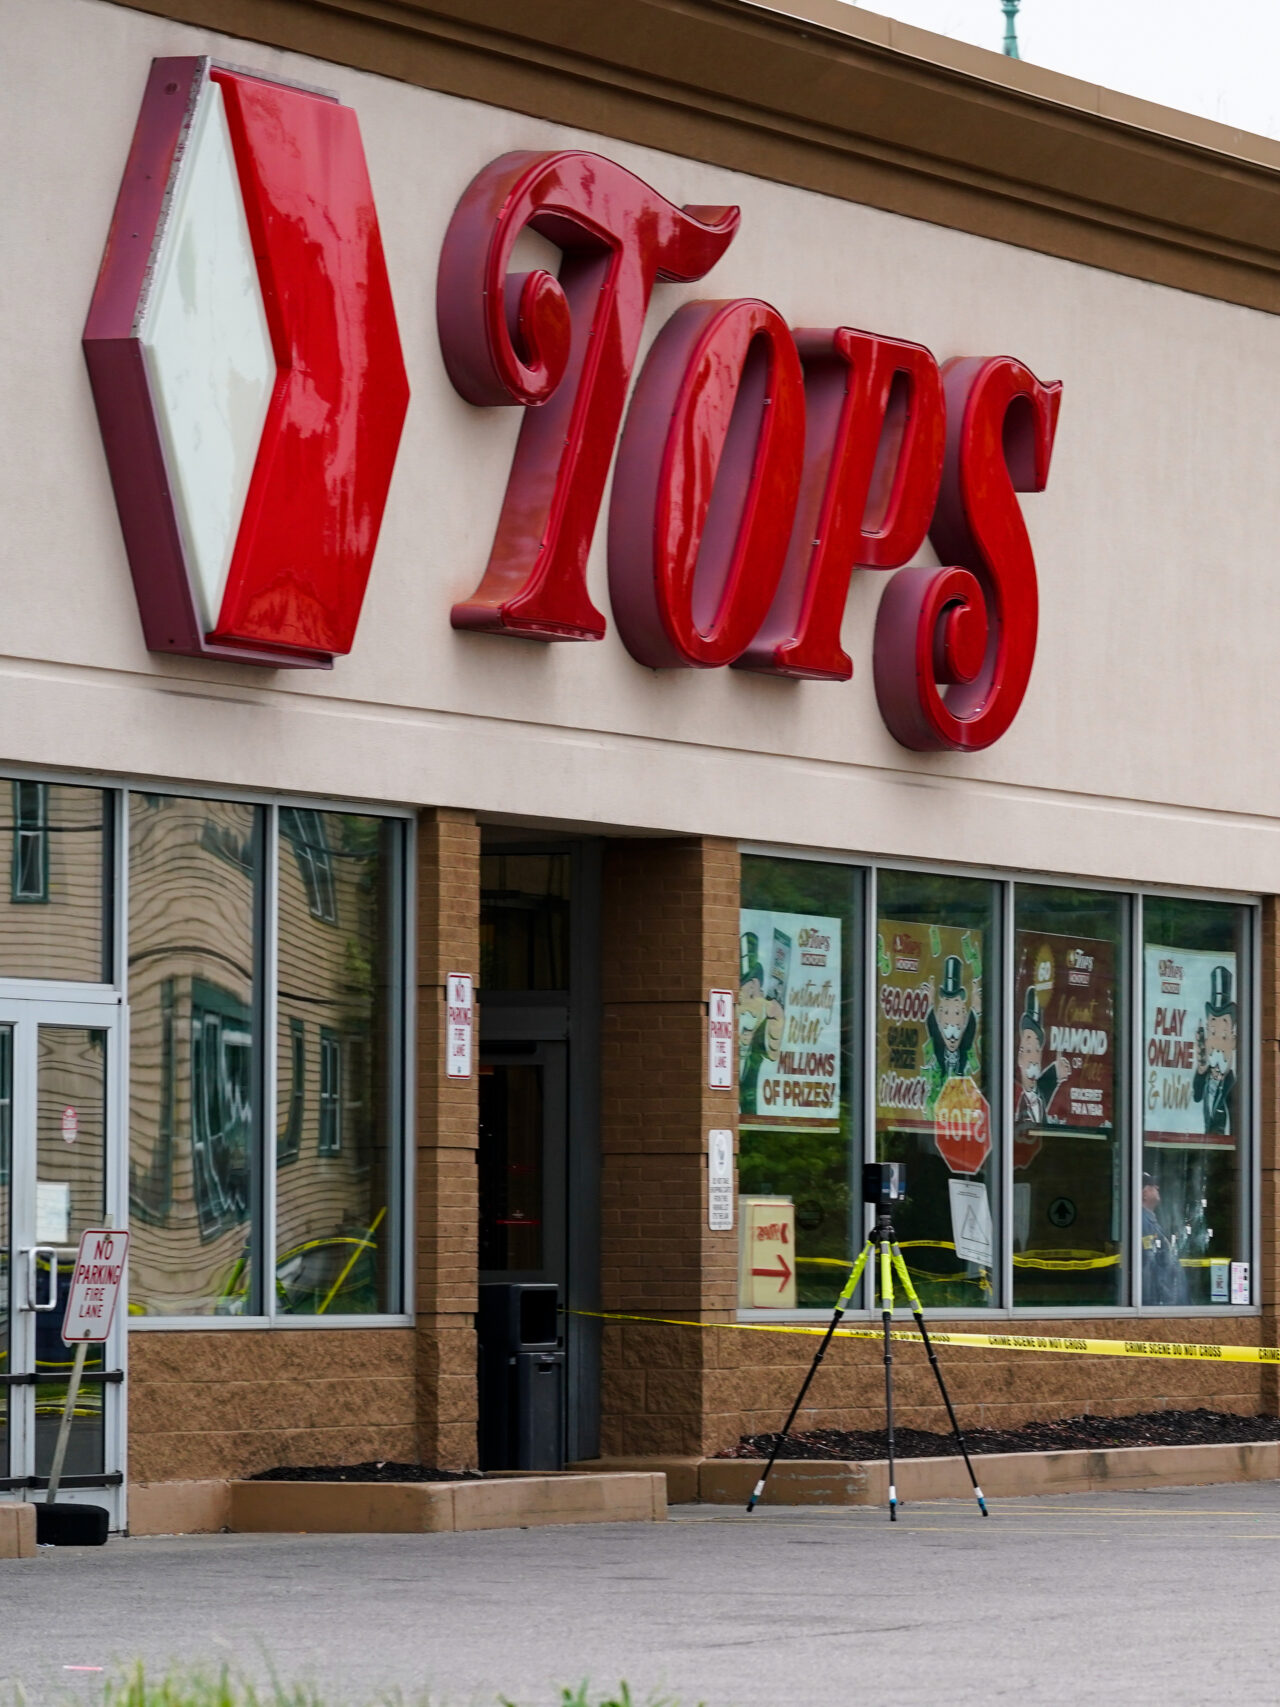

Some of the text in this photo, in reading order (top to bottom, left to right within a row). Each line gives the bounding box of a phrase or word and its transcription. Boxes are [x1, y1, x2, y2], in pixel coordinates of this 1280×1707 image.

[1154, 1007, 1187, 1037] PLAY
[1049, 1026, 1108, 1055] DIAMOND
[1148, 1038, 1194, 1069] ONLINE
[777, 1051, 835, 1077] MILLIONS
[763, 1078, 836, 1108] OF PRIZES!
[94, 1240, 114, 1260] NO
[77, 1265, 121, 1285] PARKING
[84, 1288, 106, 1302] FIRE
[79, 1305, 104, 1318] LANE
[988, 1336, 1011, 1346] CRIME
[1013, 1337, 1035, 1347] SCENE
[1037, 1338, 1047, 1348] DO
[1064, 1340, 1087, 1350] CROSS
[1125, 1342, 1221, 1356] CRIME SCENE DO NOT CROSS
[1258, 1348, 1280, 1360] CRIME
